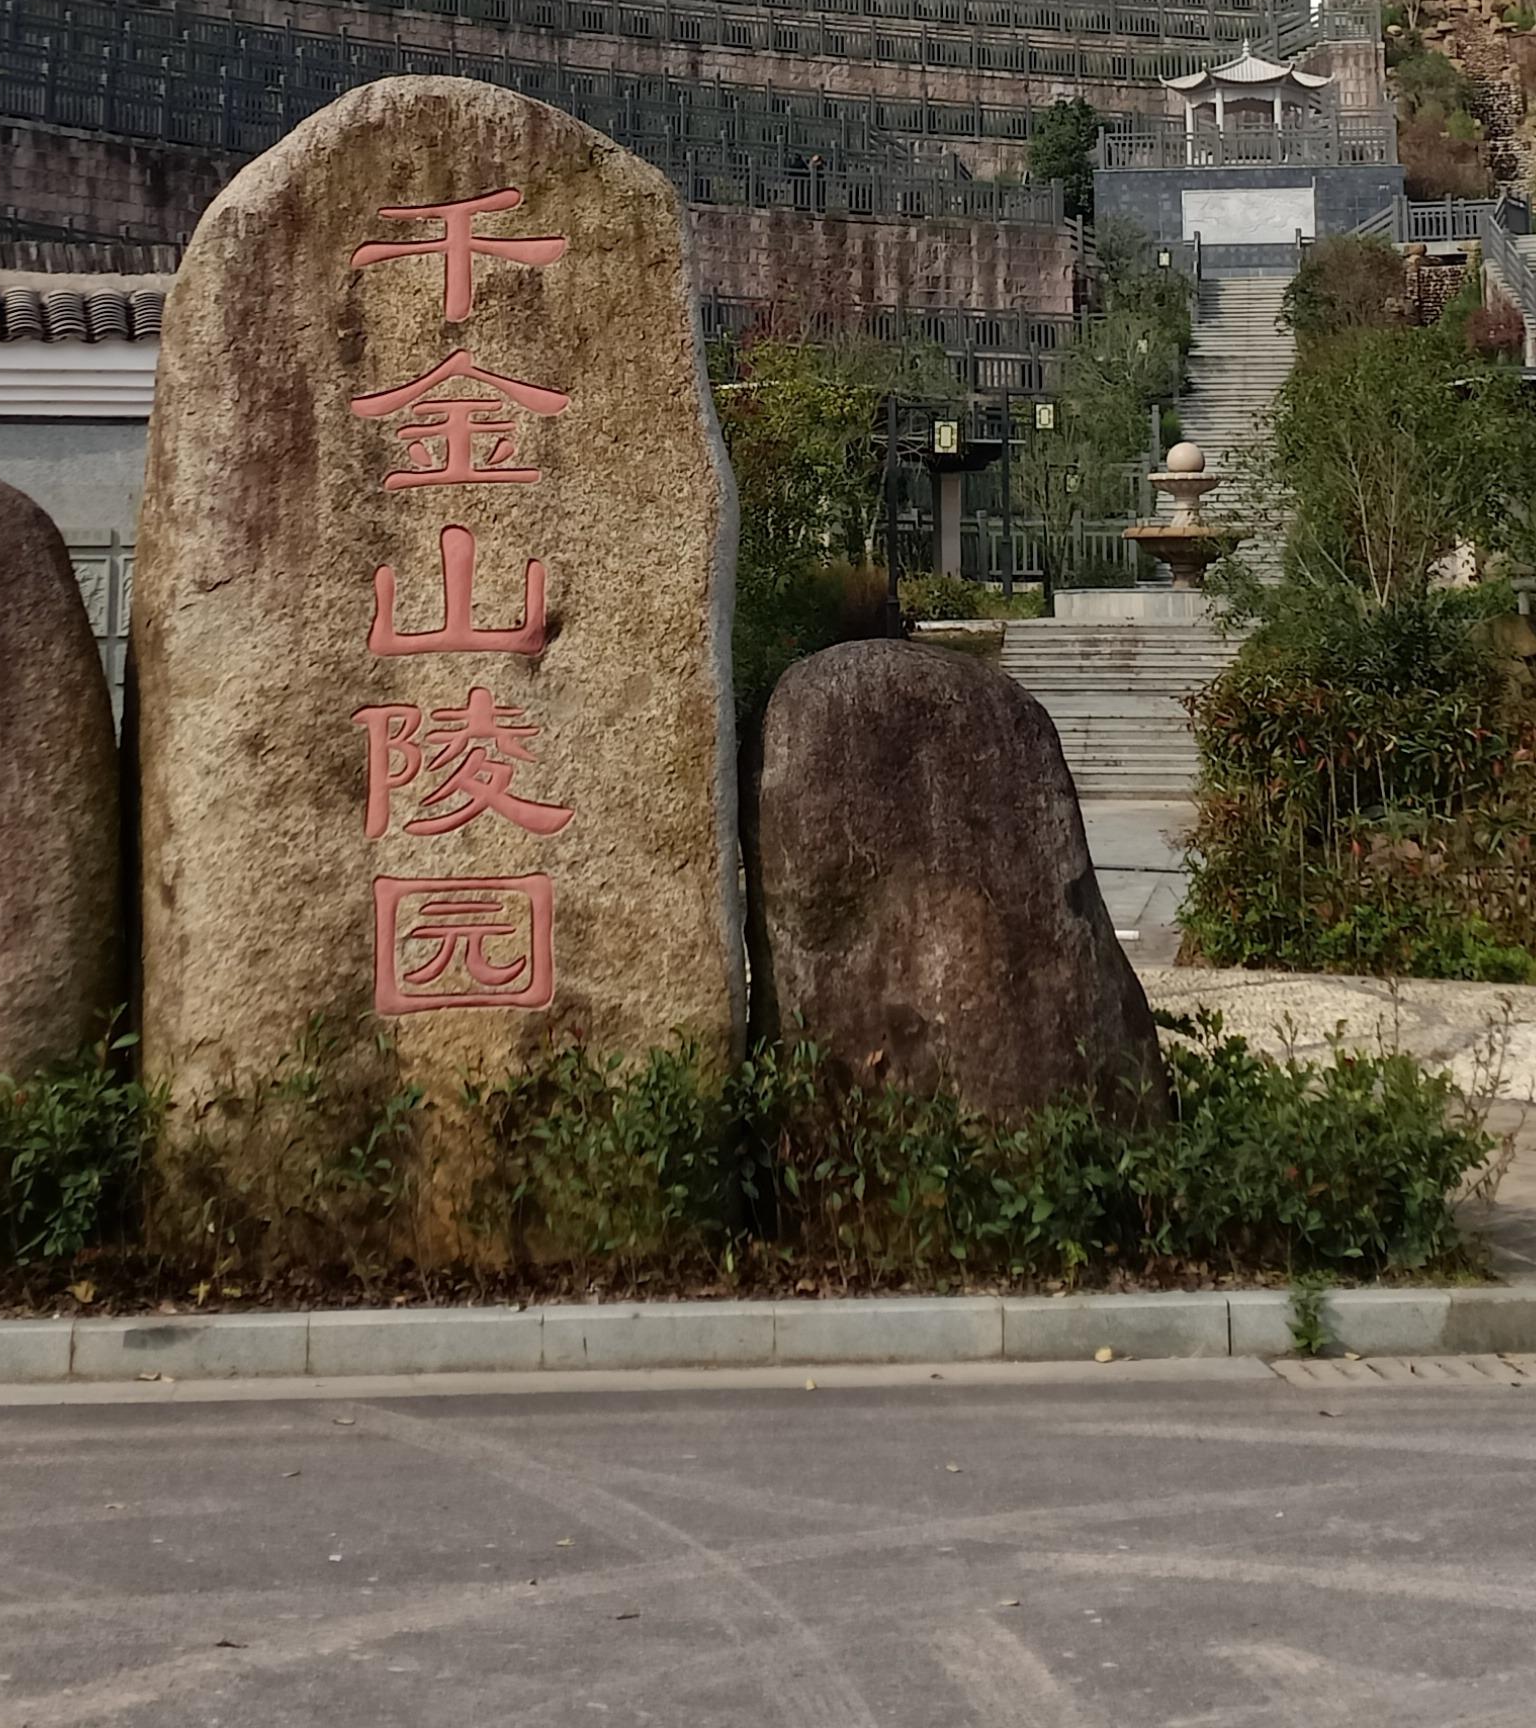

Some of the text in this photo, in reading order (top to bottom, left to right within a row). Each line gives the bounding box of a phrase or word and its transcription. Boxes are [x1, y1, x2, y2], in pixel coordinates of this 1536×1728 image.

[349, 186, 575, 1016] 千金山陵园
